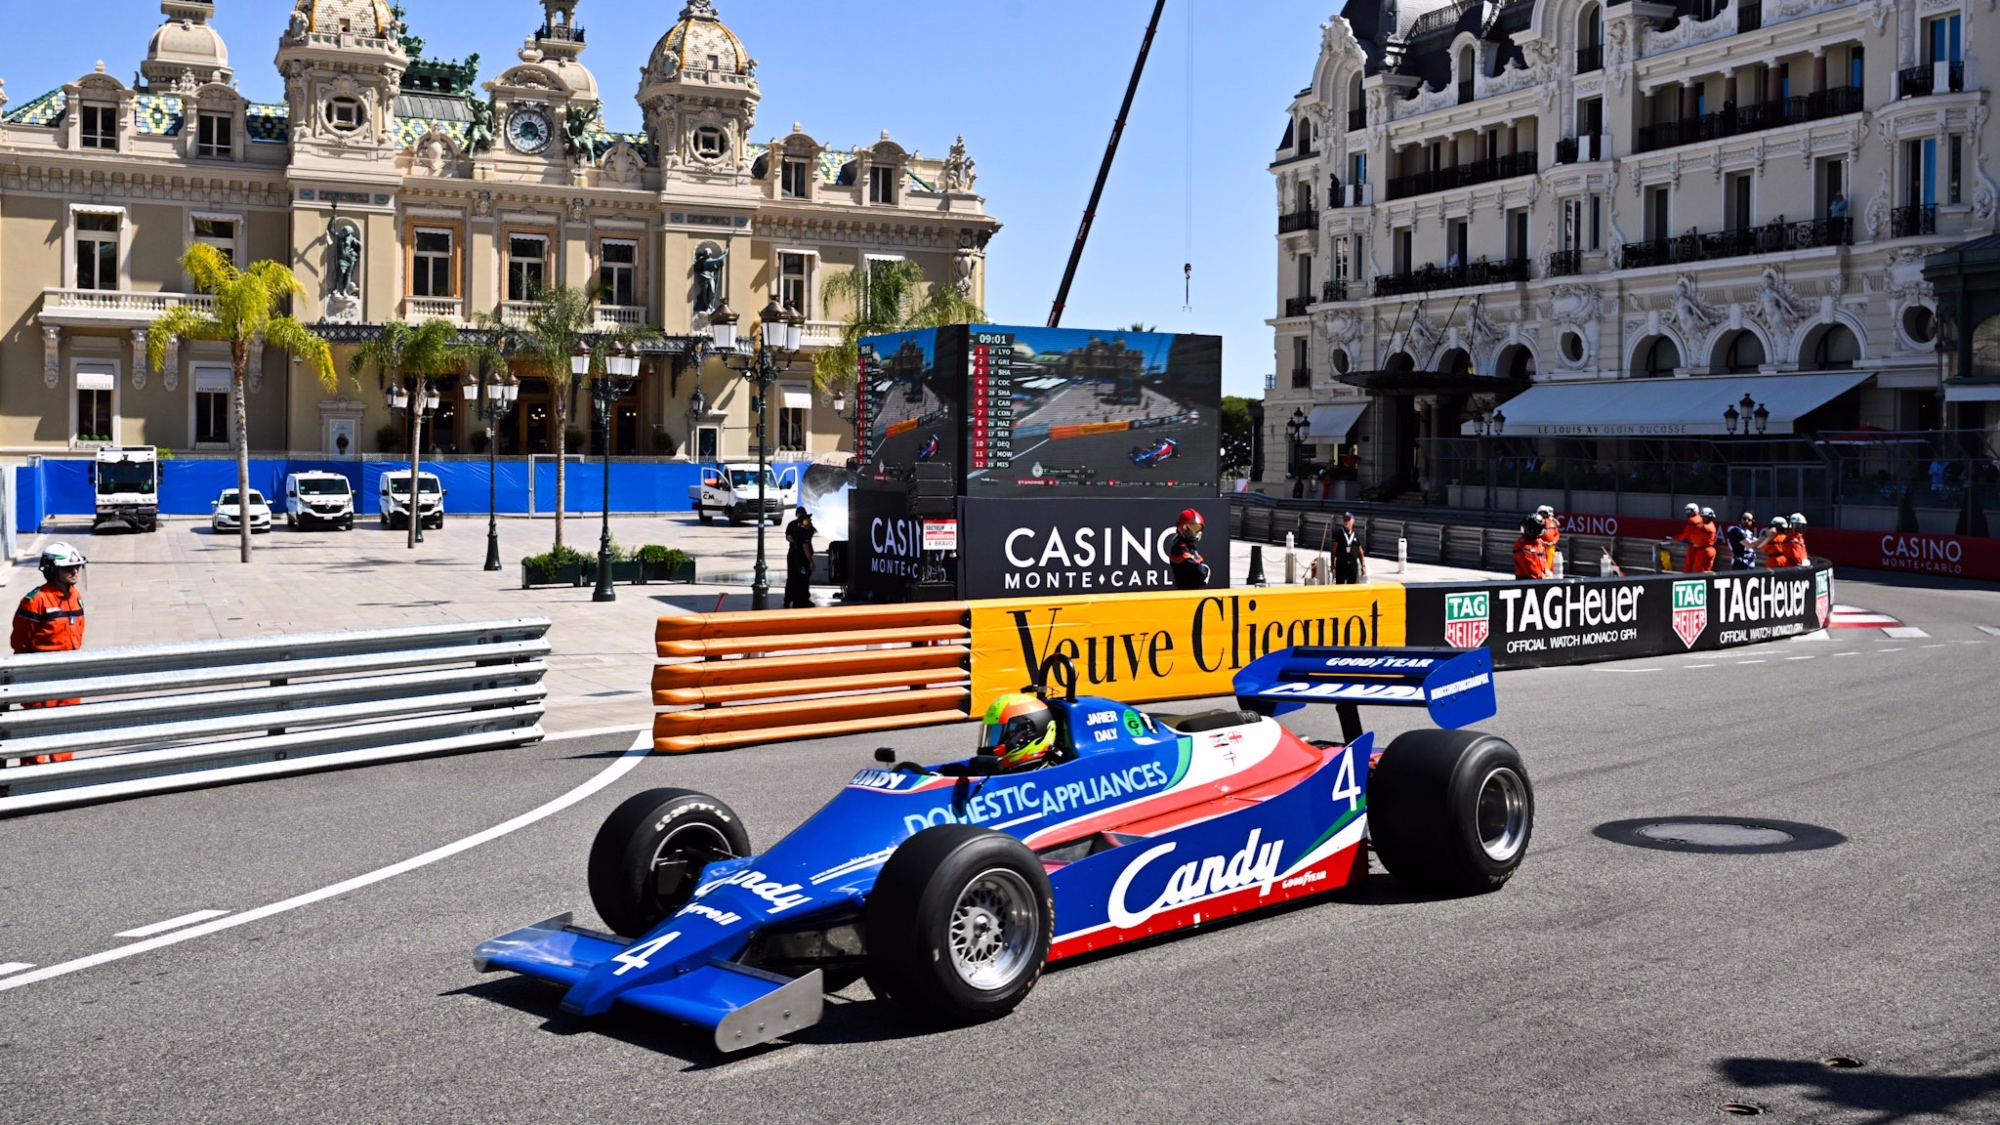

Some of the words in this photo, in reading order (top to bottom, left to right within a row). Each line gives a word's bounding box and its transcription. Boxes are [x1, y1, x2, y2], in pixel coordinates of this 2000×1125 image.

[980, 334, 1006, 344] 09:01
[1538, 425, 1548, 434] LE
[1553, 425, 1582, 434] LOUIS
[1586, 425, 1599, 433] XV
[1558, 515, 1618, 535] CASINO
[1882, 535, 1962, 562] CASINO
[872, 558, 906, 576] MONTE
[1882, 558, 1919, 569] MONTE
[1926, 562, 1962, 574] CARLO
[1005, 572, 1093, 590] MONTE
[1111, 570, 1173, 587] CARL
[1676, 585, 1704, 606] TAG
[1449, 596, 1486, 619] TAG
[1674, 611, 1706, 645] HEUER
[1720, 630, 1748, 644] OFFICIAL
[1750, 627, 1772, 640] WATCH
[1772, 624, 1793, 636] MONACO
[1794, 622, 1804, 634] GPH
[1006, 606, 1174, 688] Veuve
[1506, 638, 1547, 654] OFFICIAL
[1550, 634, 1580, 649] WATCH
[1582, 630, 1618, 645] MONACO
[1620, 628, 1637, 641] GPH
[1257, 682, 1426, 700] CAND
[1086, 710, 1118, 726] JARIER
[1094, 728, 1118, 742] DALY
[850, 770, 907, 790] ANDY
[1331, 746, 1362, 812] 4
[904, 782, 1040, 835] DOMESTIC
[1041, 761, 1168, 817] APPLIANCES
[1108, 828, 1284, 930] Candy
[610, 930, 682, 976] 4
